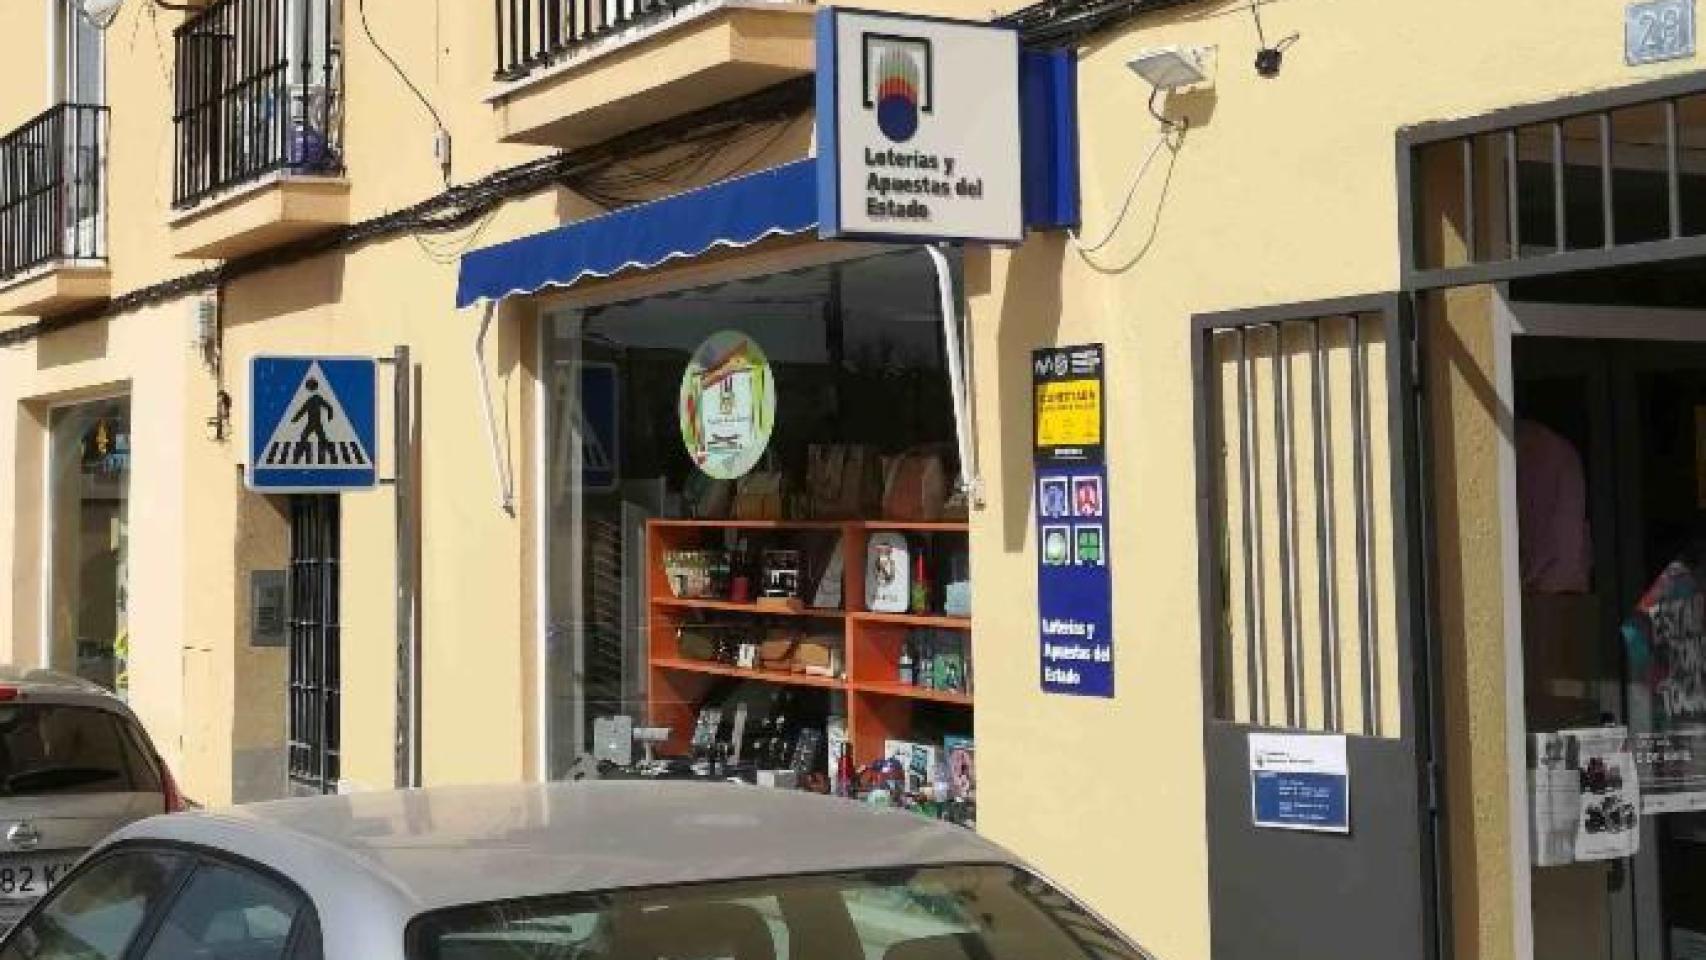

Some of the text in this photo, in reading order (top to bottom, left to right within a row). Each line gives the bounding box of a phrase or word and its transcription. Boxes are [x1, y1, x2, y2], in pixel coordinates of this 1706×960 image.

[943, 157, 955, 176] y
[867, 172, 983, 197] Apuestas del
[867, 197, 929, 218] Estado
[1086, 623, 1095, 640] y
[1044, 642, 1110, 662] Apuestas del
[1044, 666, 1081, 684] Estado
